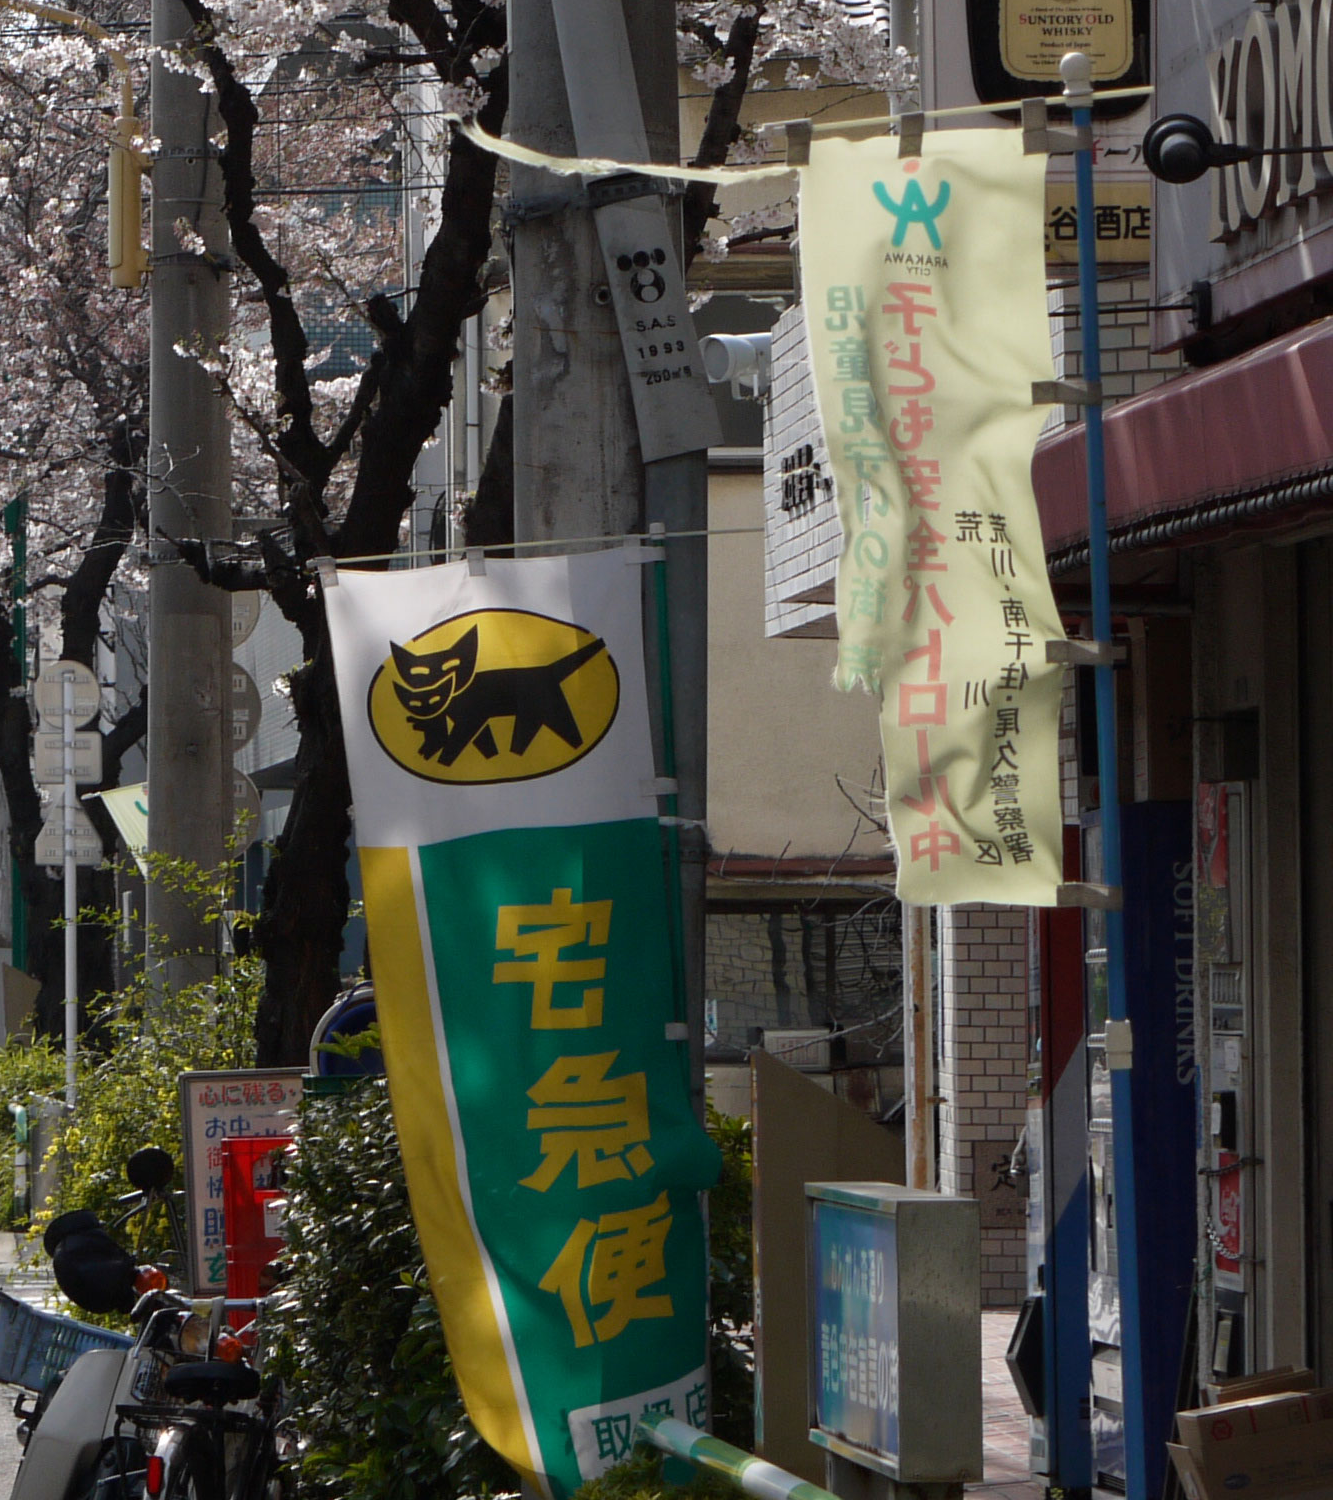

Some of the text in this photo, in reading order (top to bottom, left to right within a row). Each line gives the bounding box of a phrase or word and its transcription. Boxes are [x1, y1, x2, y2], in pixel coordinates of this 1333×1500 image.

[1019, 13, 1114, 25] SUNTORY OLD
[1042, 26, 1093, 36] WHISKY
[1045, 205, 1151, 242] 谷酒店
[637, 340, 685, 359] 1993
[492, 886, 675, 1350] 宅急便
